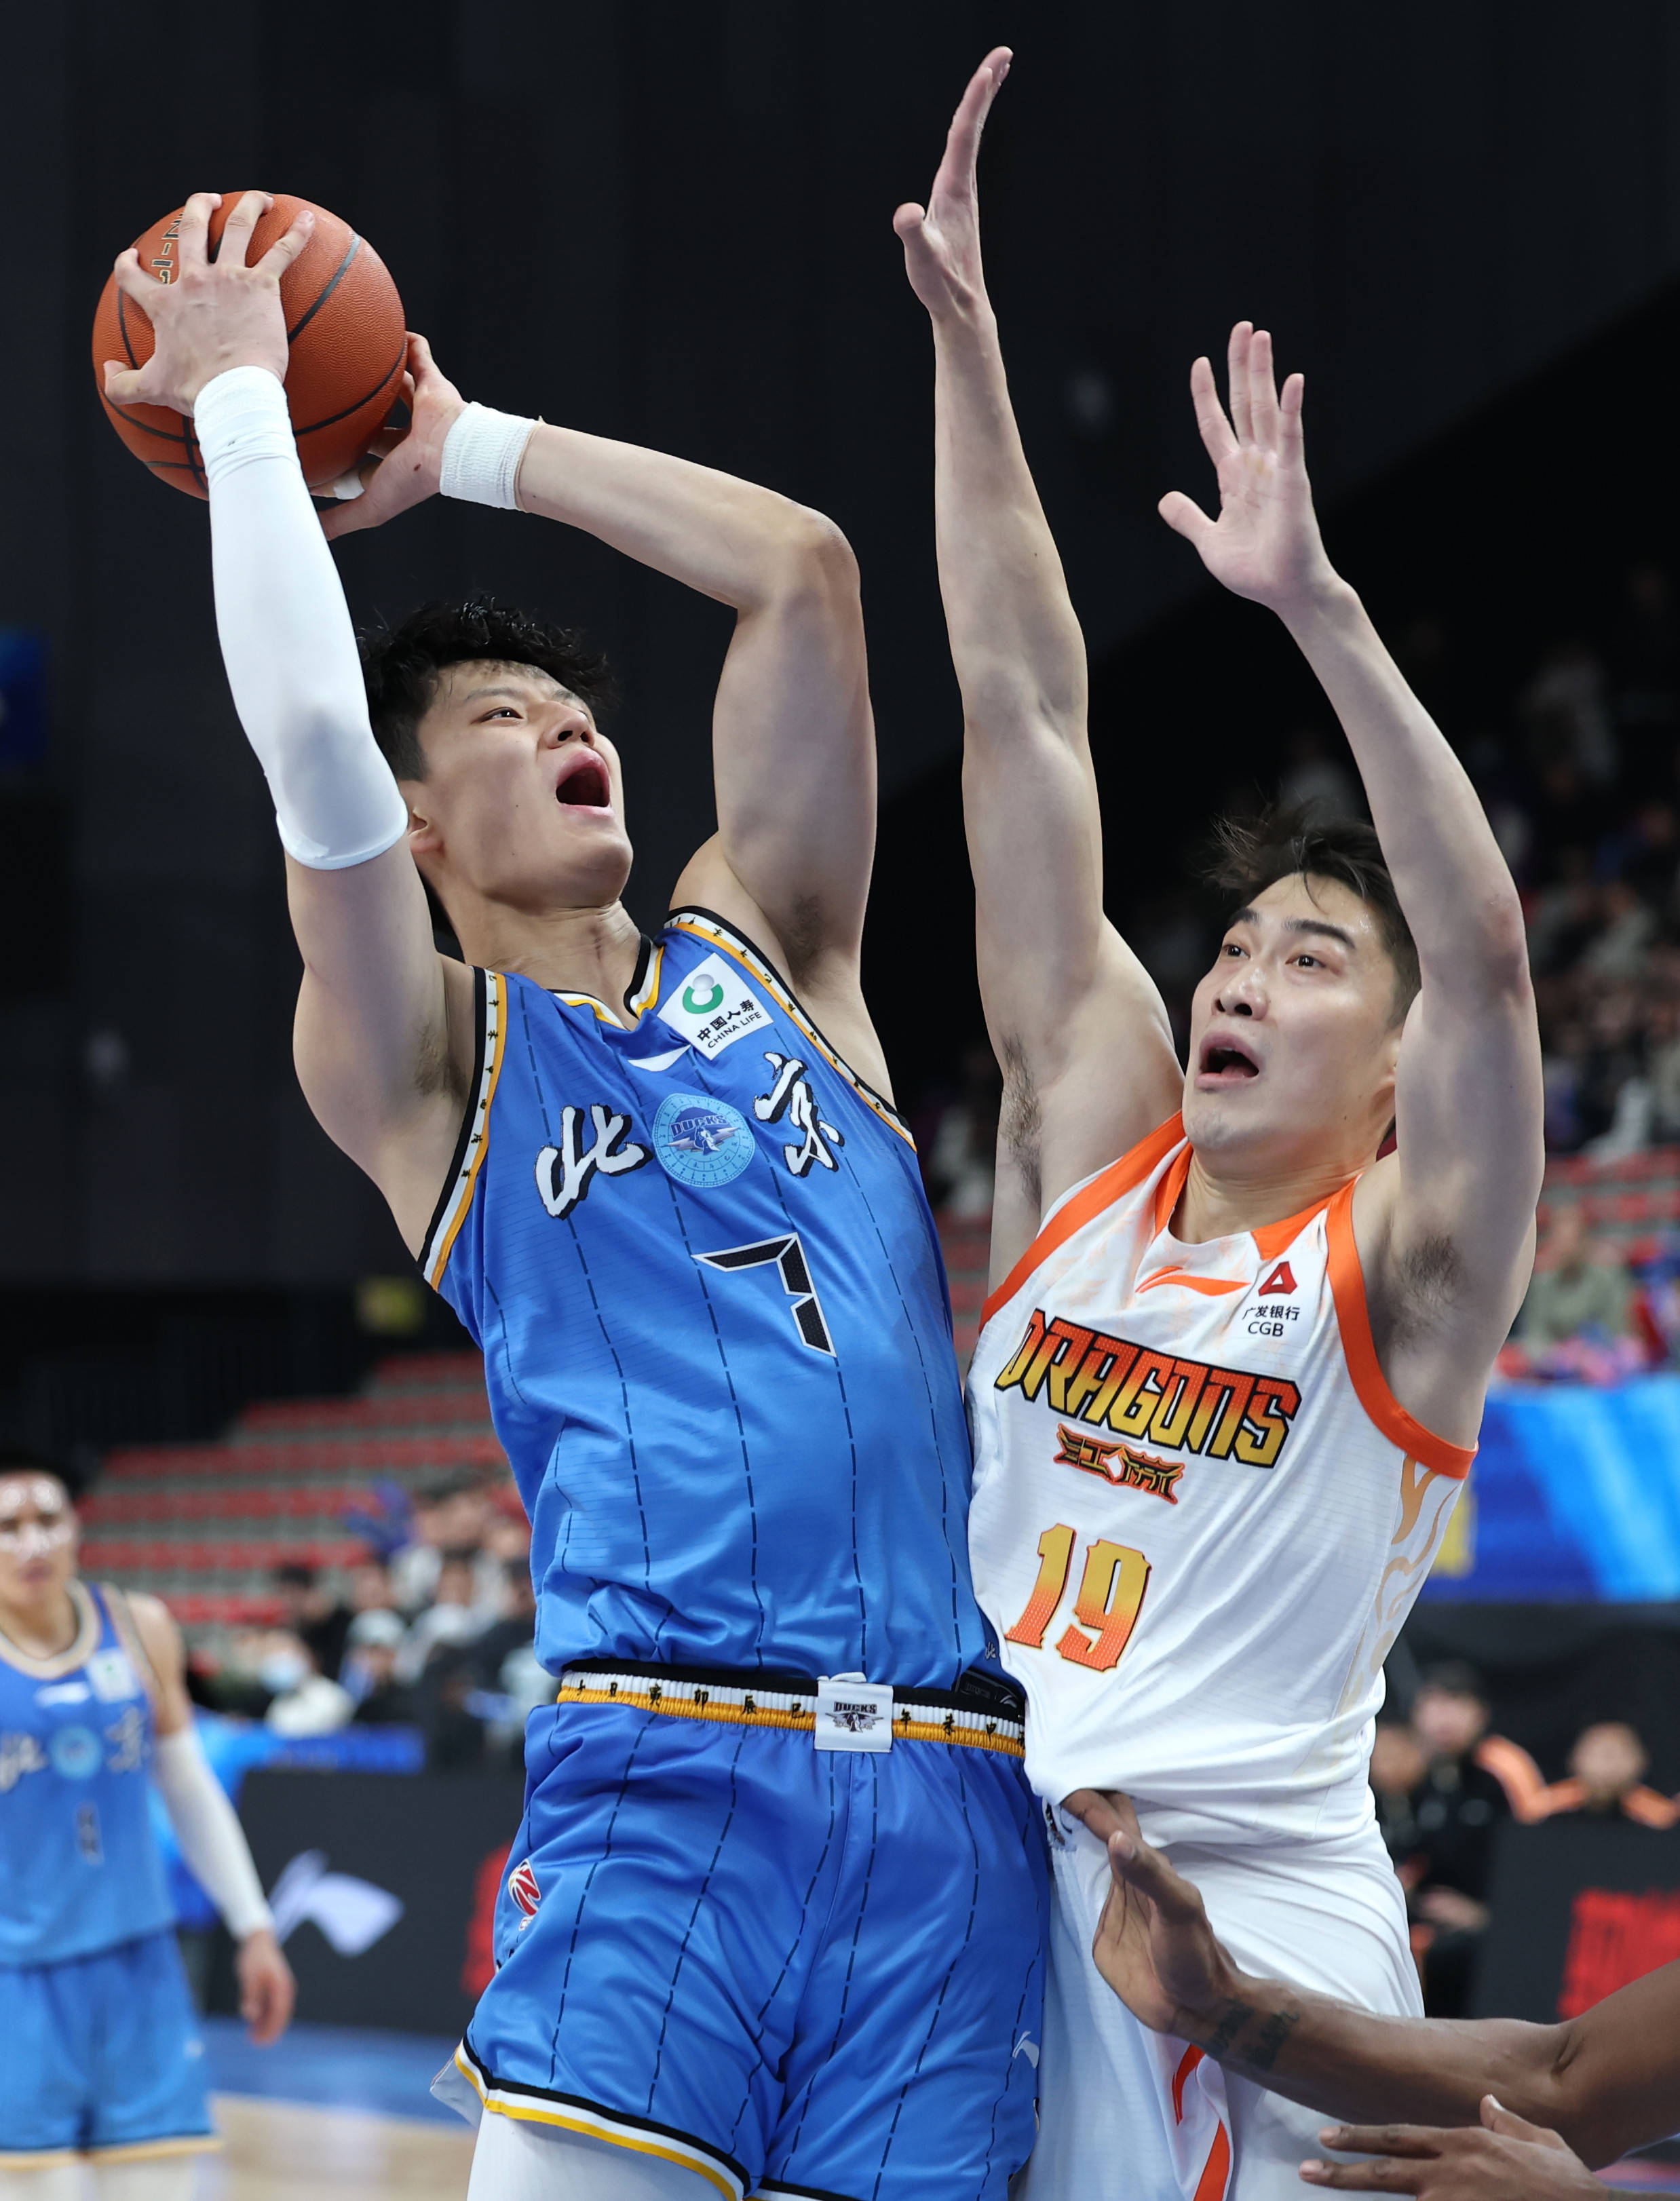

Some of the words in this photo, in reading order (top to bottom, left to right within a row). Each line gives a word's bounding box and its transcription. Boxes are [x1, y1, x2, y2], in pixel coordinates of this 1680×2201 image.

[697, 999, 755, 1041] 中国人寿
[708, 1025, 740, 1048] CHINA
[740, 1012, 762, 1026] LIFE
[669, 1115, 729, 1138] DUCKS
[689, 1231, 837, 1358] 7
[1242, 1305, 1300, 1321] 广发银行
[1248, 1321, 1284, 1337] CGB
[994, 1308, 1302, 1469] DRAGONS
[1004, 1523, 1152, 1673] 19
[833, 1701, 877, 1715] DUCKS
